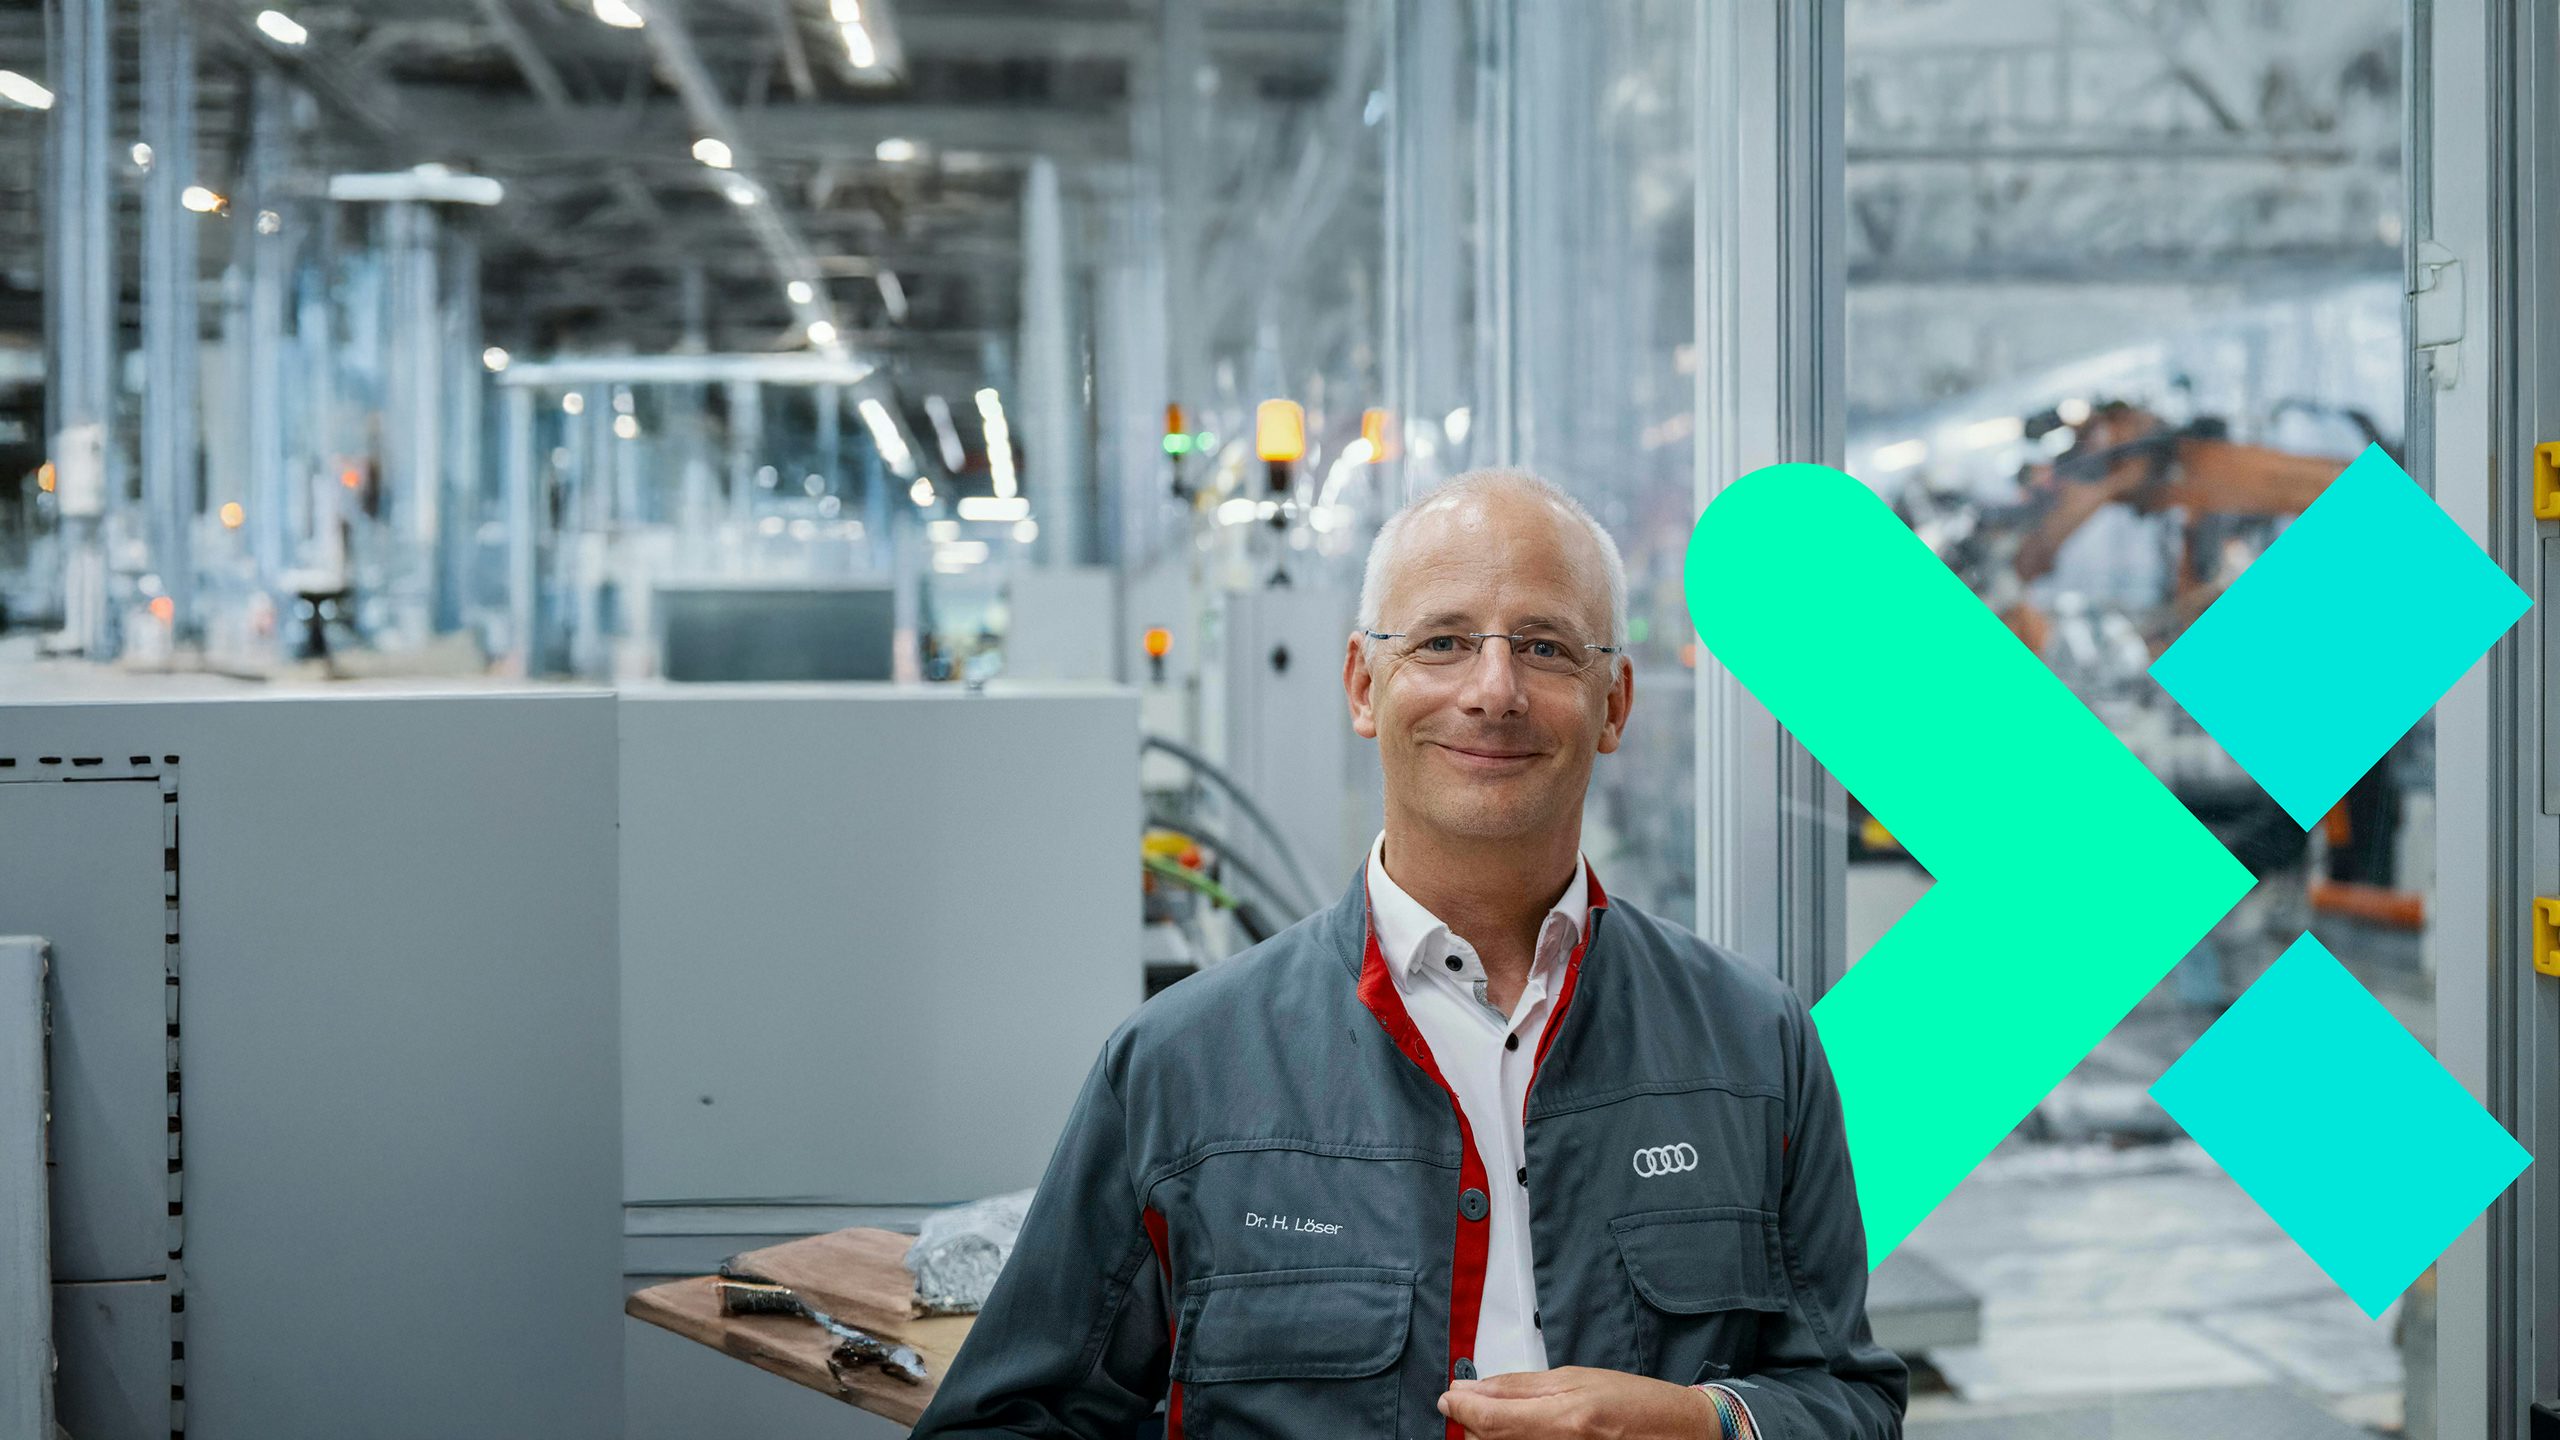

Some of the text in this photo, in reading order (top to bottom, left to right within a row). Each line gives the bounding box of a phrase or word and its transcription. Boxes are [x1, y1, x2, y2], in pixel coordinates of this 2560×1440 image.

[1245, 1212, 1344, 1235] Dr. H. Löser
